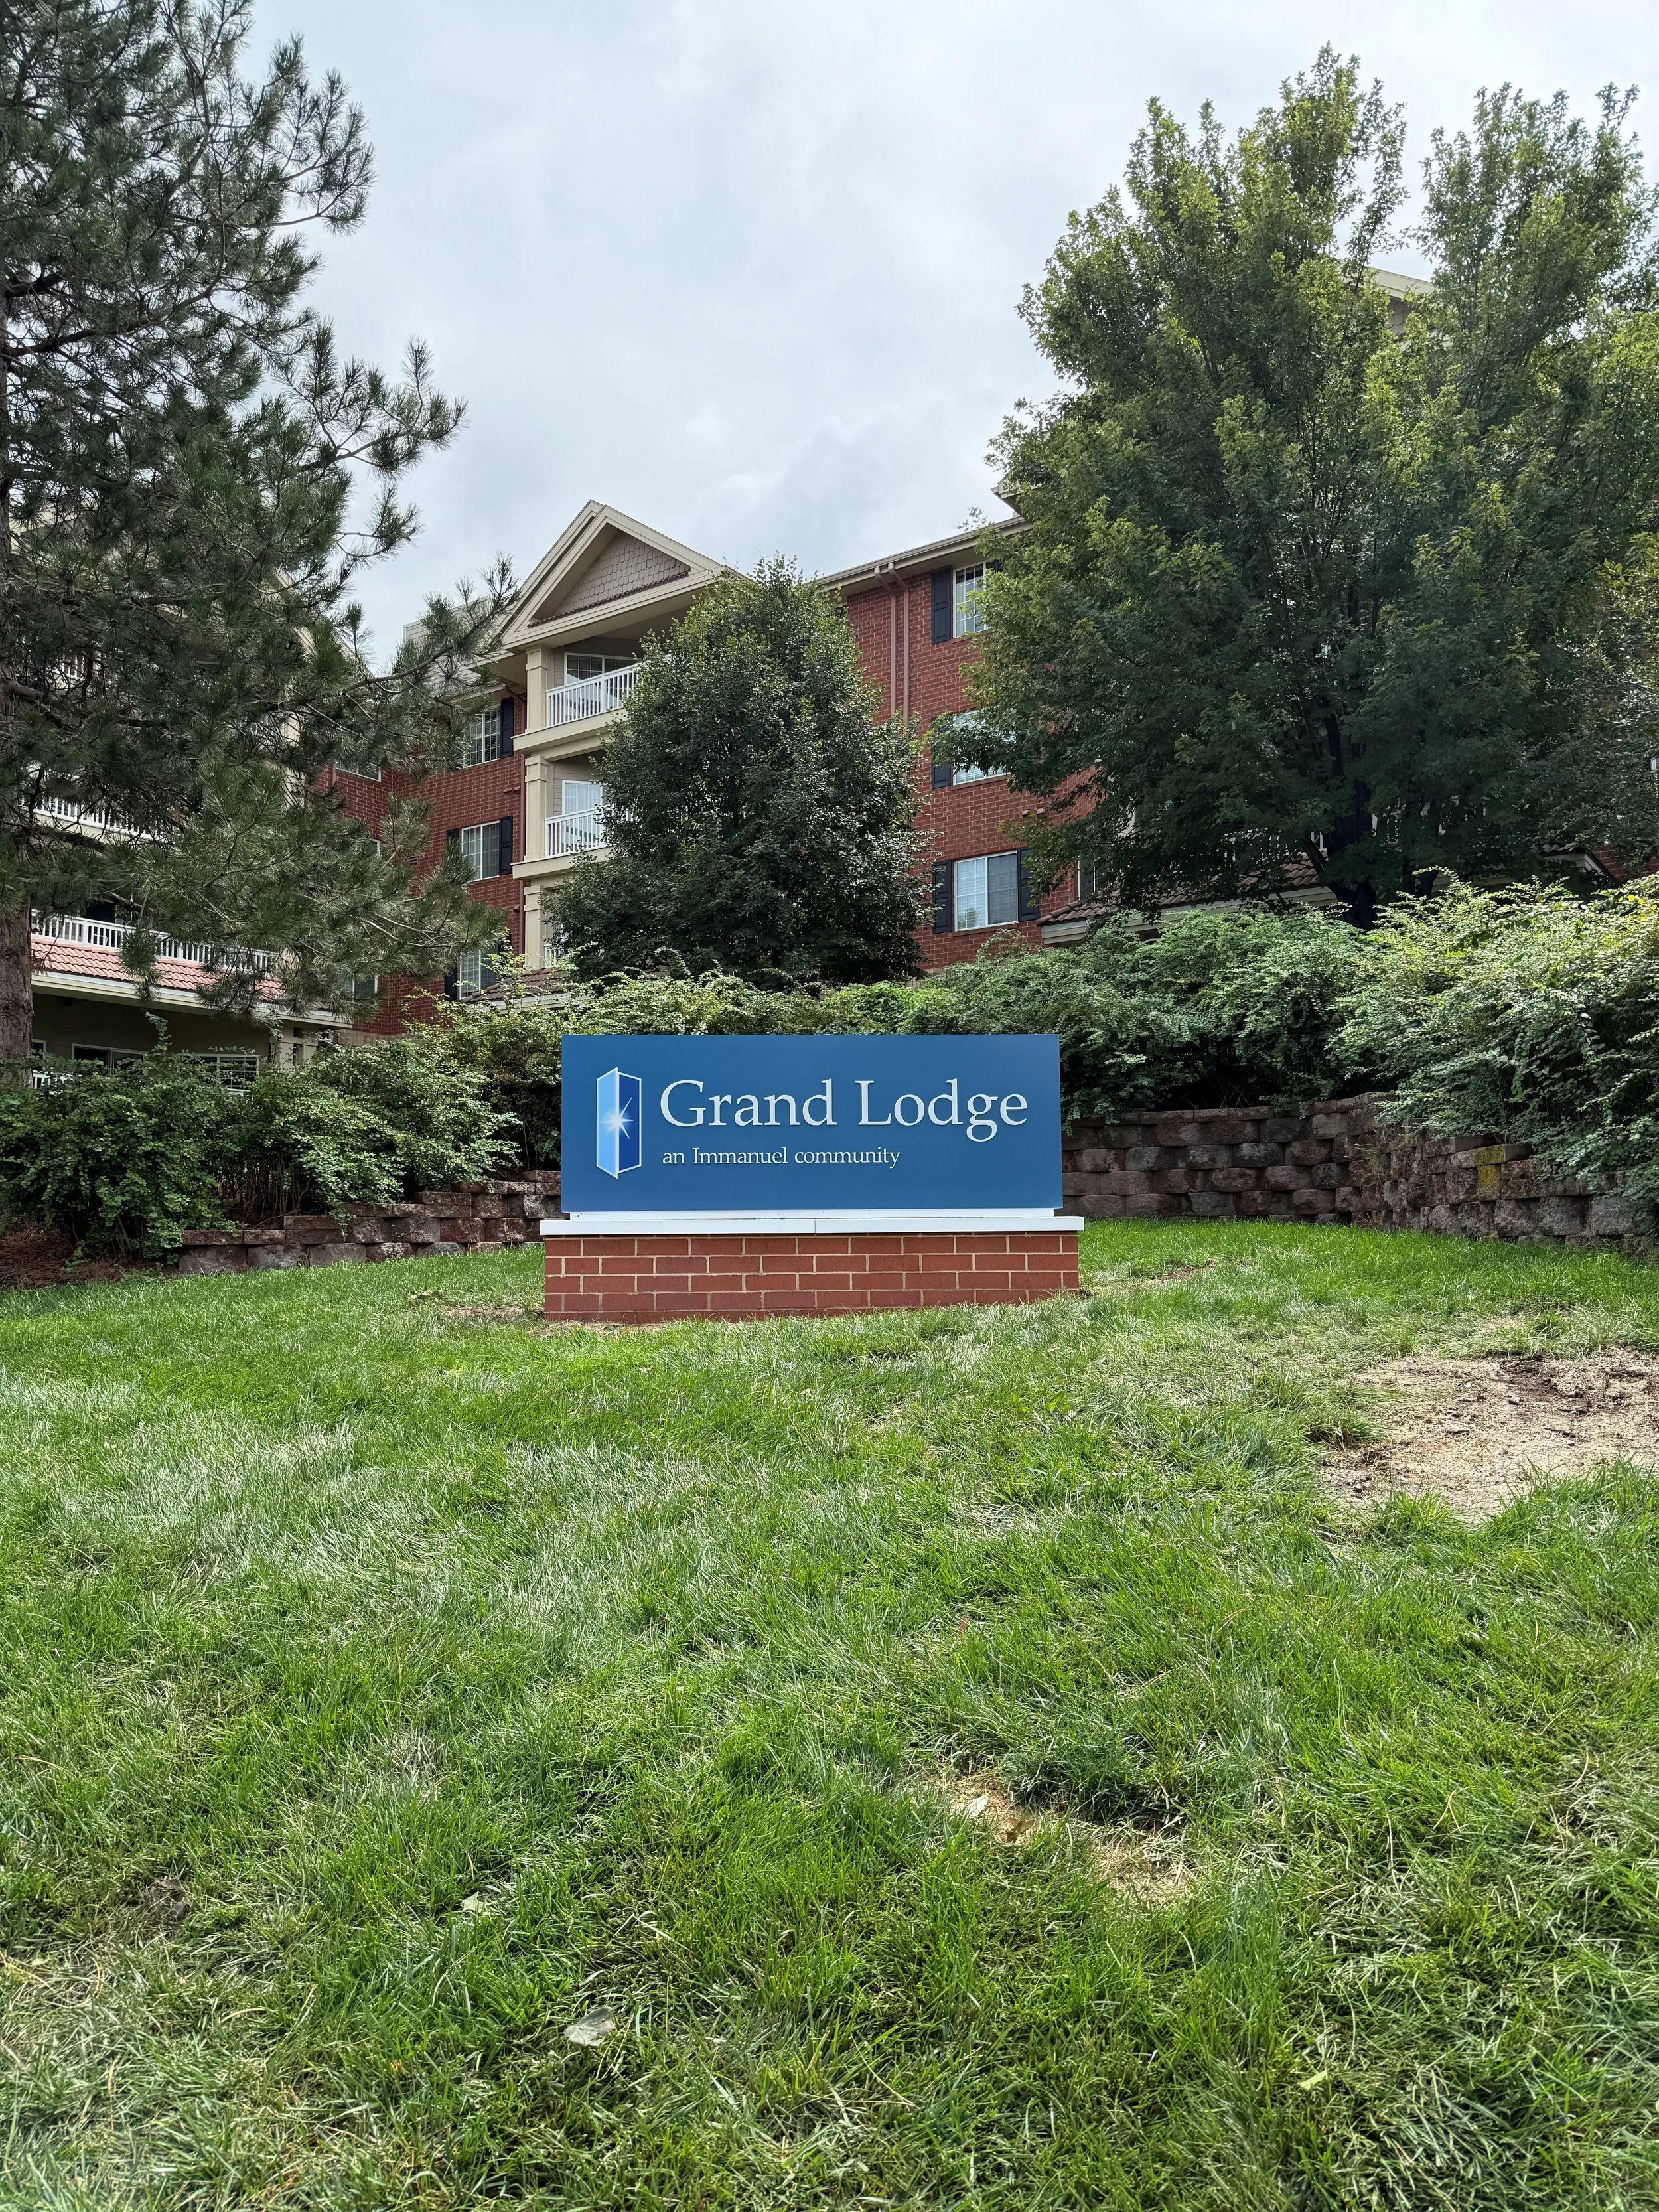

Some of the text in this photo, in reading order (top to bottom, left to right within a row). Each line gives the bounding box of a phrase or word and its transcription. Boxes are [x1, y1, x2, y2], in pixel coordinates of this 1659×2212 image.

[661, 1078, 1027, 1142] Grand Lodge
[663, 1147, 901, 1168] an Immanuel community
